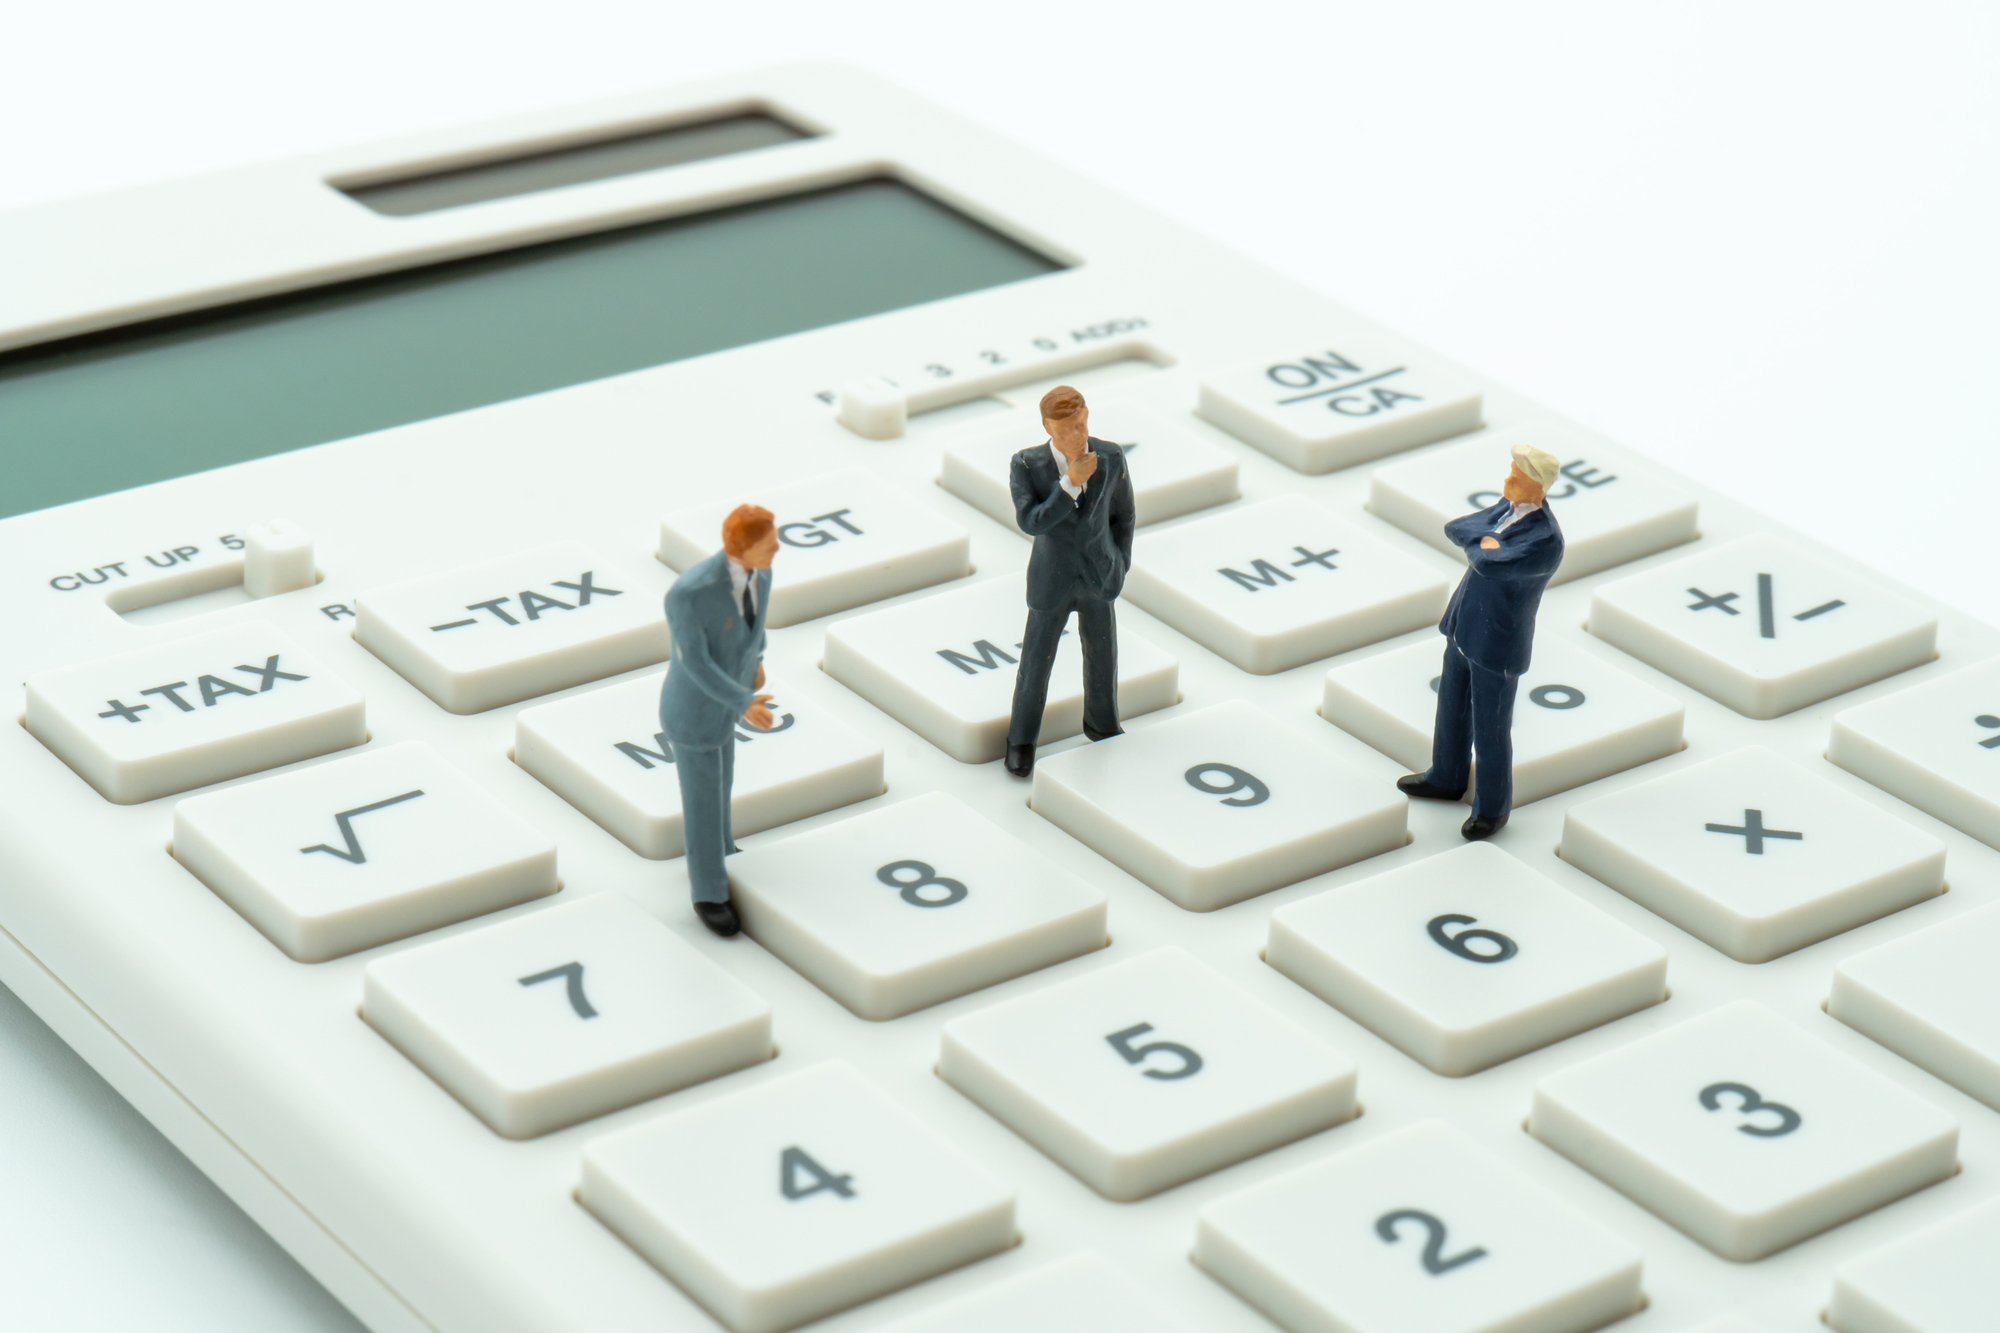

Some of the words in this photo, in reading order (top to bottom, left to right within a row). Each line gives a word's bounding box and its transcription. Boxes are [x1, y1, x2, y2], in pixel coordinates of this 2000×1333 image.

[980, 351, 1006, 365] 2
[1266, 351, 1362, 388] ON
[1327, 384, 1423, 417] CA
[777, 508, 864, 548] GT
[49, 561, 129, 592] CUT
[144, 545, 200, 568] UP
[1217, 545, 1340, 592] M+
[430, 571, 624, 631] -TAX
[98, 654, 310, 723] +TAX
[1184, 763, 1271, 808] 9
[876, 859, 968, 909] 8
[1426, 913, 1519, 964] 6
[517, 960, 599, 1020] 7
[1104, 1022, 1204, 1082] 5
[1698, 1081, 1802, 1138] 3
[779, 1146, 858, 1203] 4
[1373, 1207, 1489, 1277] 2
